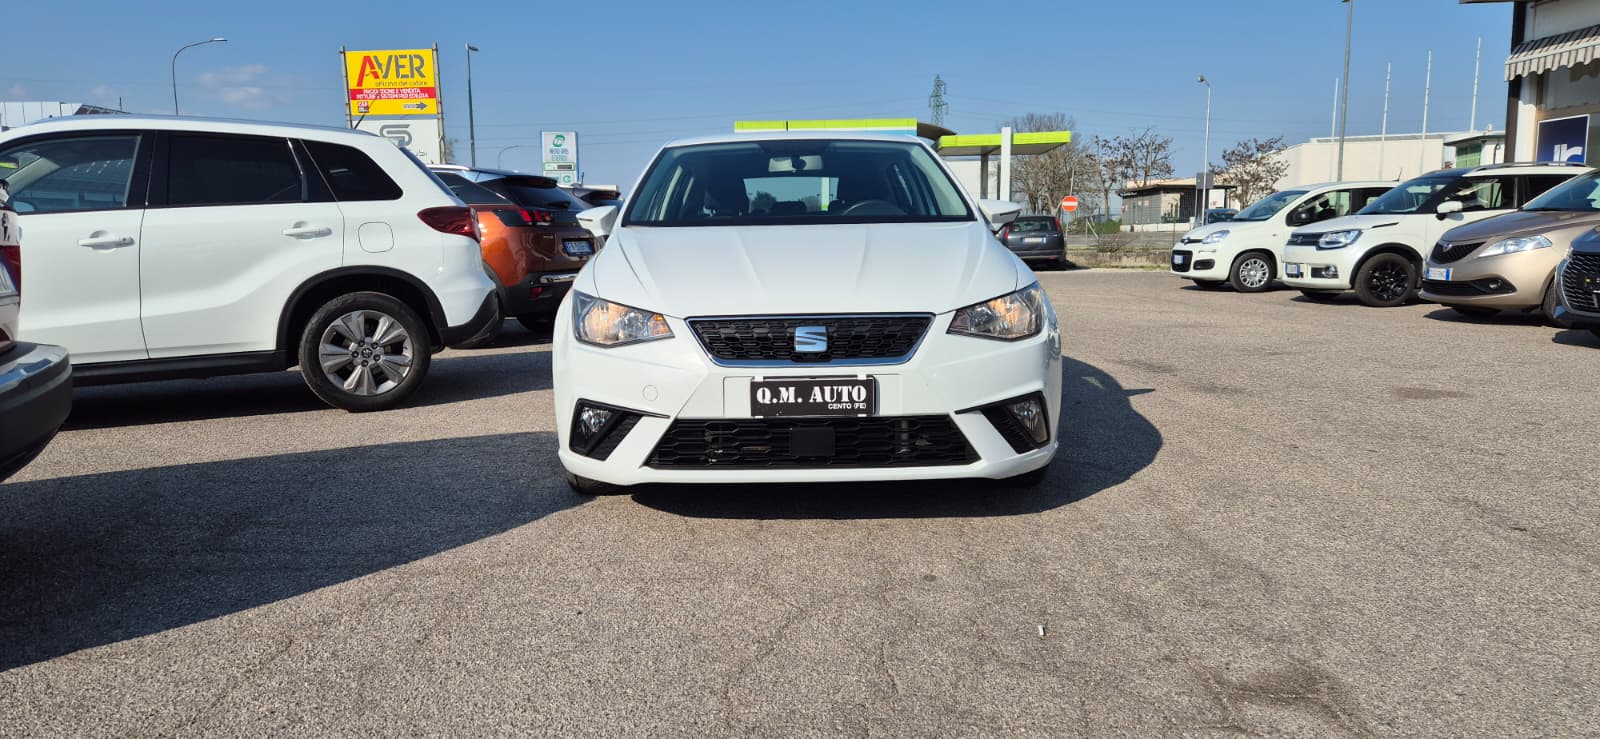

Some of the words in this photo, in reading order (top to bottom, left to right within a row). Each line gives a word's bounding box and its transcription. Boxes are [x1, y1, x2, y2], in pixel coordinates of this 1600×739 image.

[357, 54, 426, 87] AVER
[756, 387, 803, 404] Q.M.
[809, 385, 867, 403] AUTO
